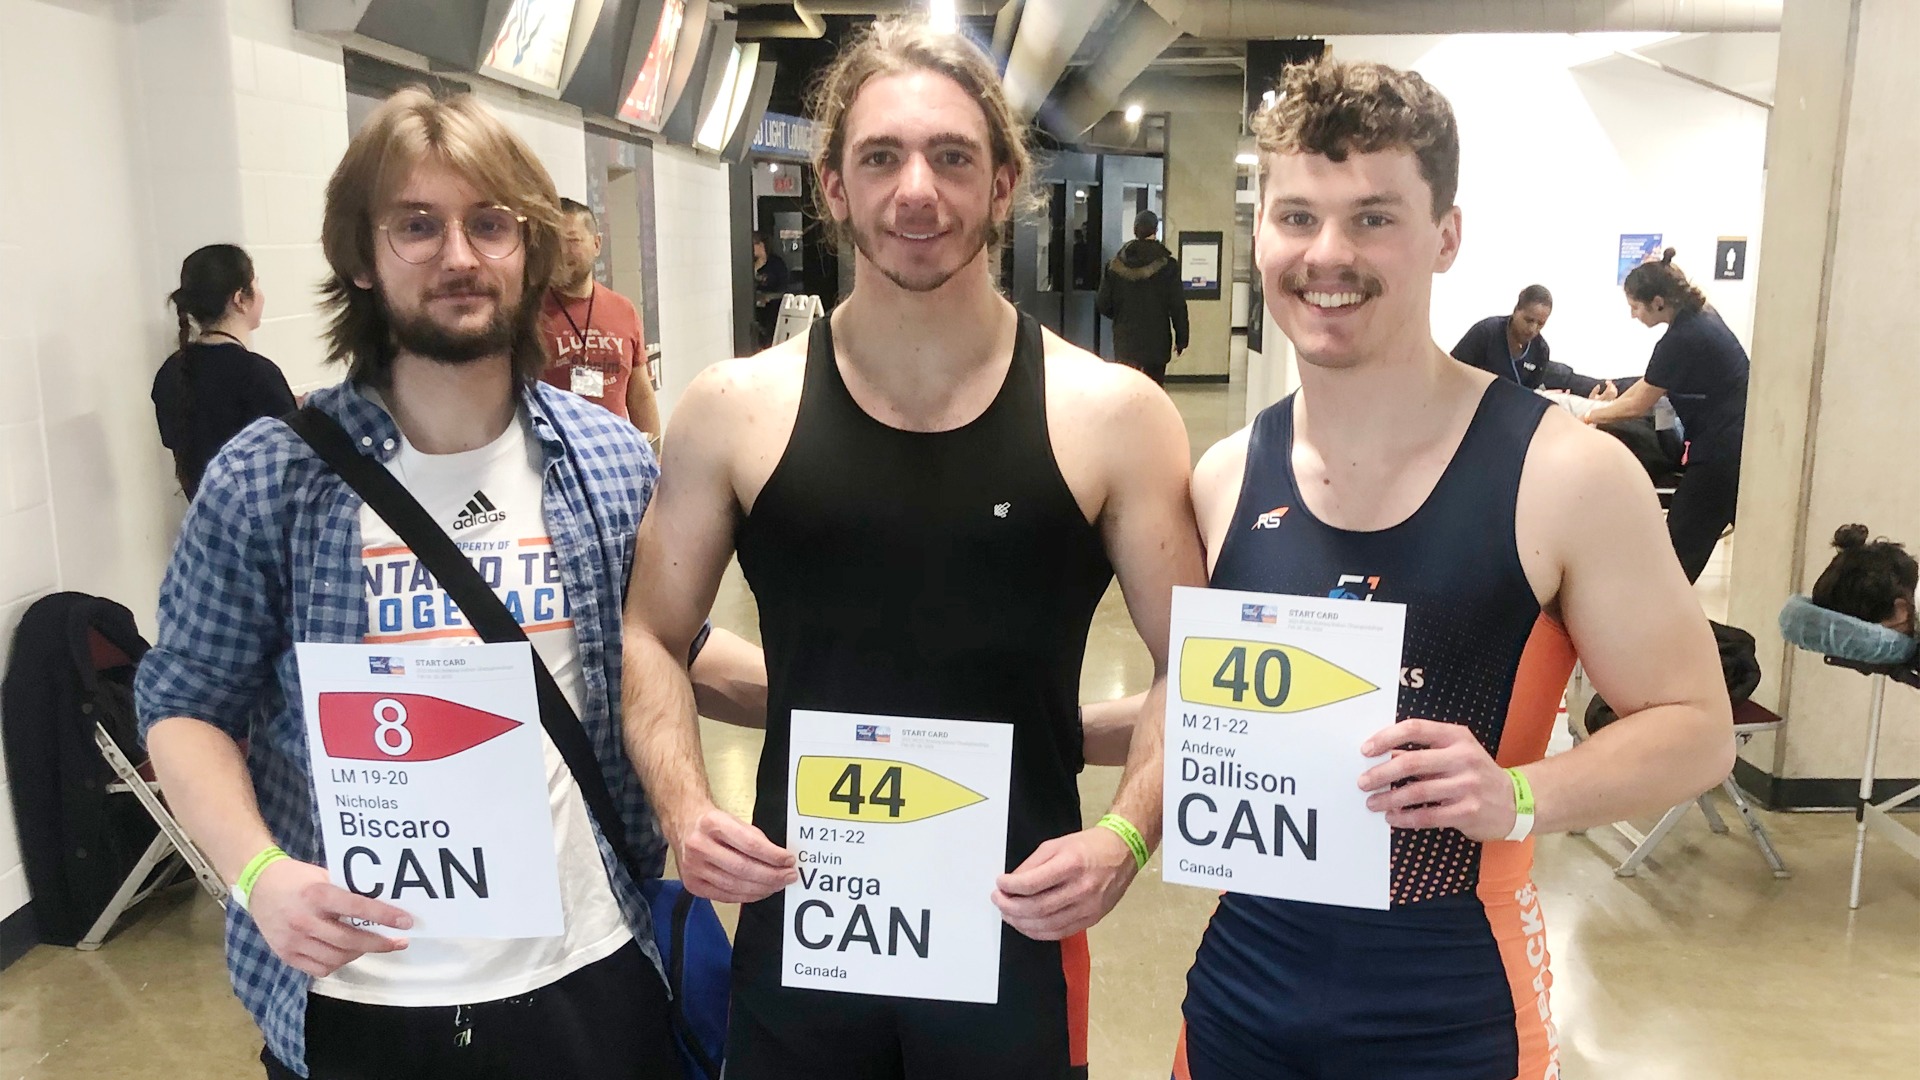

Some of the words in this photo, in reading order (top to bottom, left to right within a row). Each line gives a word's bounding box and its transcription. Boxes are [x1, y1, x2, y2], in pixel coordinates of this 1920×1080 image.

[764, 119, 786, 149] LIGHT
[556, 336, 623, 356] LUCKY
[453, 510, 506, 530] adidas
[497, 540, 510, 550] OF
[1289, 609, 1315, 619] START
[1316, 611, 1339, 620] CARD
[415, 659, 441, 667] START
[443, 658, 466, 666] CARD
[1213, 647, 1291, 707] 40
[373, 698, 413, 756] 8
[902, 729, 927, 738] START
[927, 730, 949, 738] CARD
[1182, 713, 1197, 728] M
[1202, 715, 1249, 734] 21-22
[1181, 740, 1236, 758] Andrew
[331, 768, 356, 784] LM
[362, 770, 409, 785] 19-20
[1182, 757, 1296, 795] Dallison
[829, 764, 906, 818] 44
[335, 794, 398, 810] Nicholas
[339, 811, 450, 838] Biscaro
[1177, 792, 1317, 861] CAN
[799, 826, 814, 840] M
[819, 828, 865, 844] 21-22
[798, 850, 842, 865] Calvin
[343, 846, 489, 900] CAN
[1179, 859, 1233, 879] Canada
[798, 867, 881, 900] Varga
[794, 899, 931, 959] CAN
[794, 962, 847, 979] Canada
